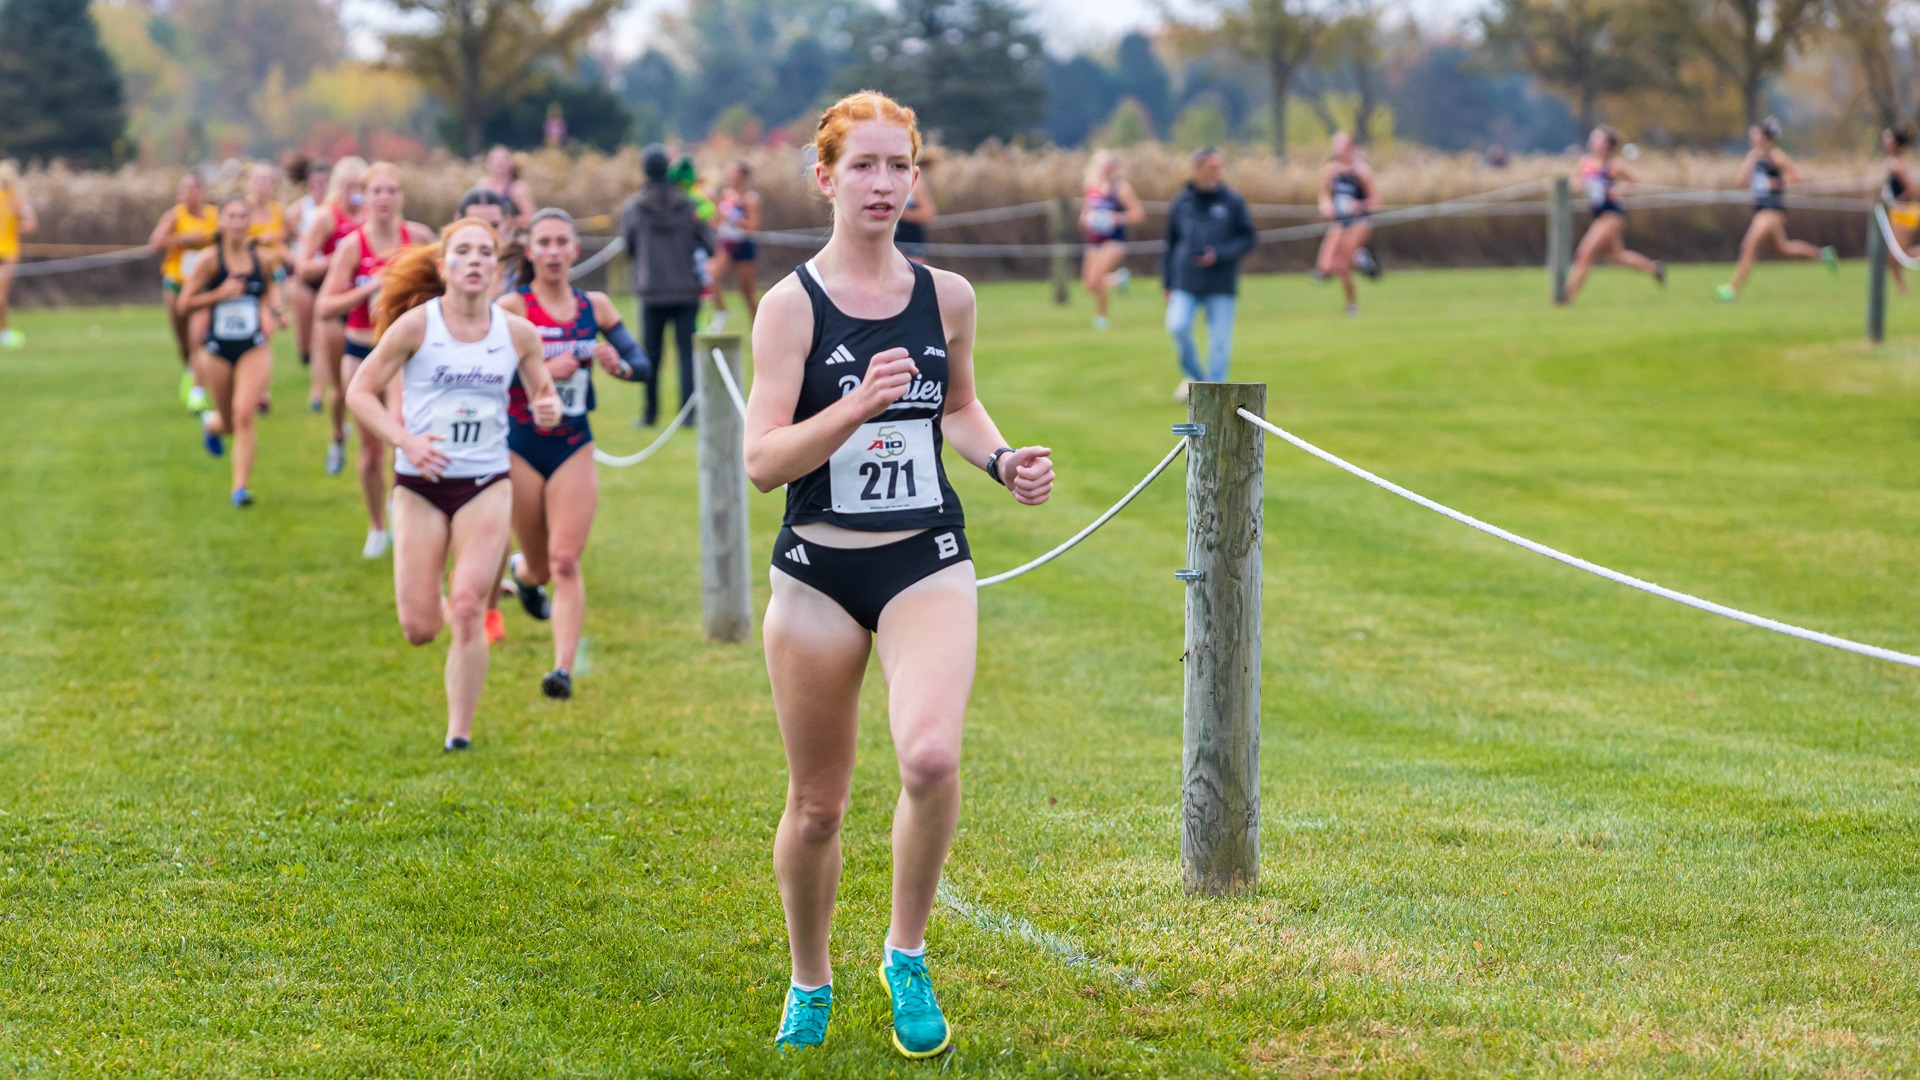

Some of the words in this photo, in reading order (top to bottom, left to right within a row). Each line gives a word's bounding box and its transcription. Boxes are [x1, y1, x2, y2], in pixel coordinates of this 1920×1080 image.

[923, 346, 946, 358] A10
[432, 364, 504, 385] Fordham
[450, 421, 481, 443] 177
[866, 439, 903, 451] A10
[859, 459, 917, 501] 271
[934, 531, 960, 560] B
